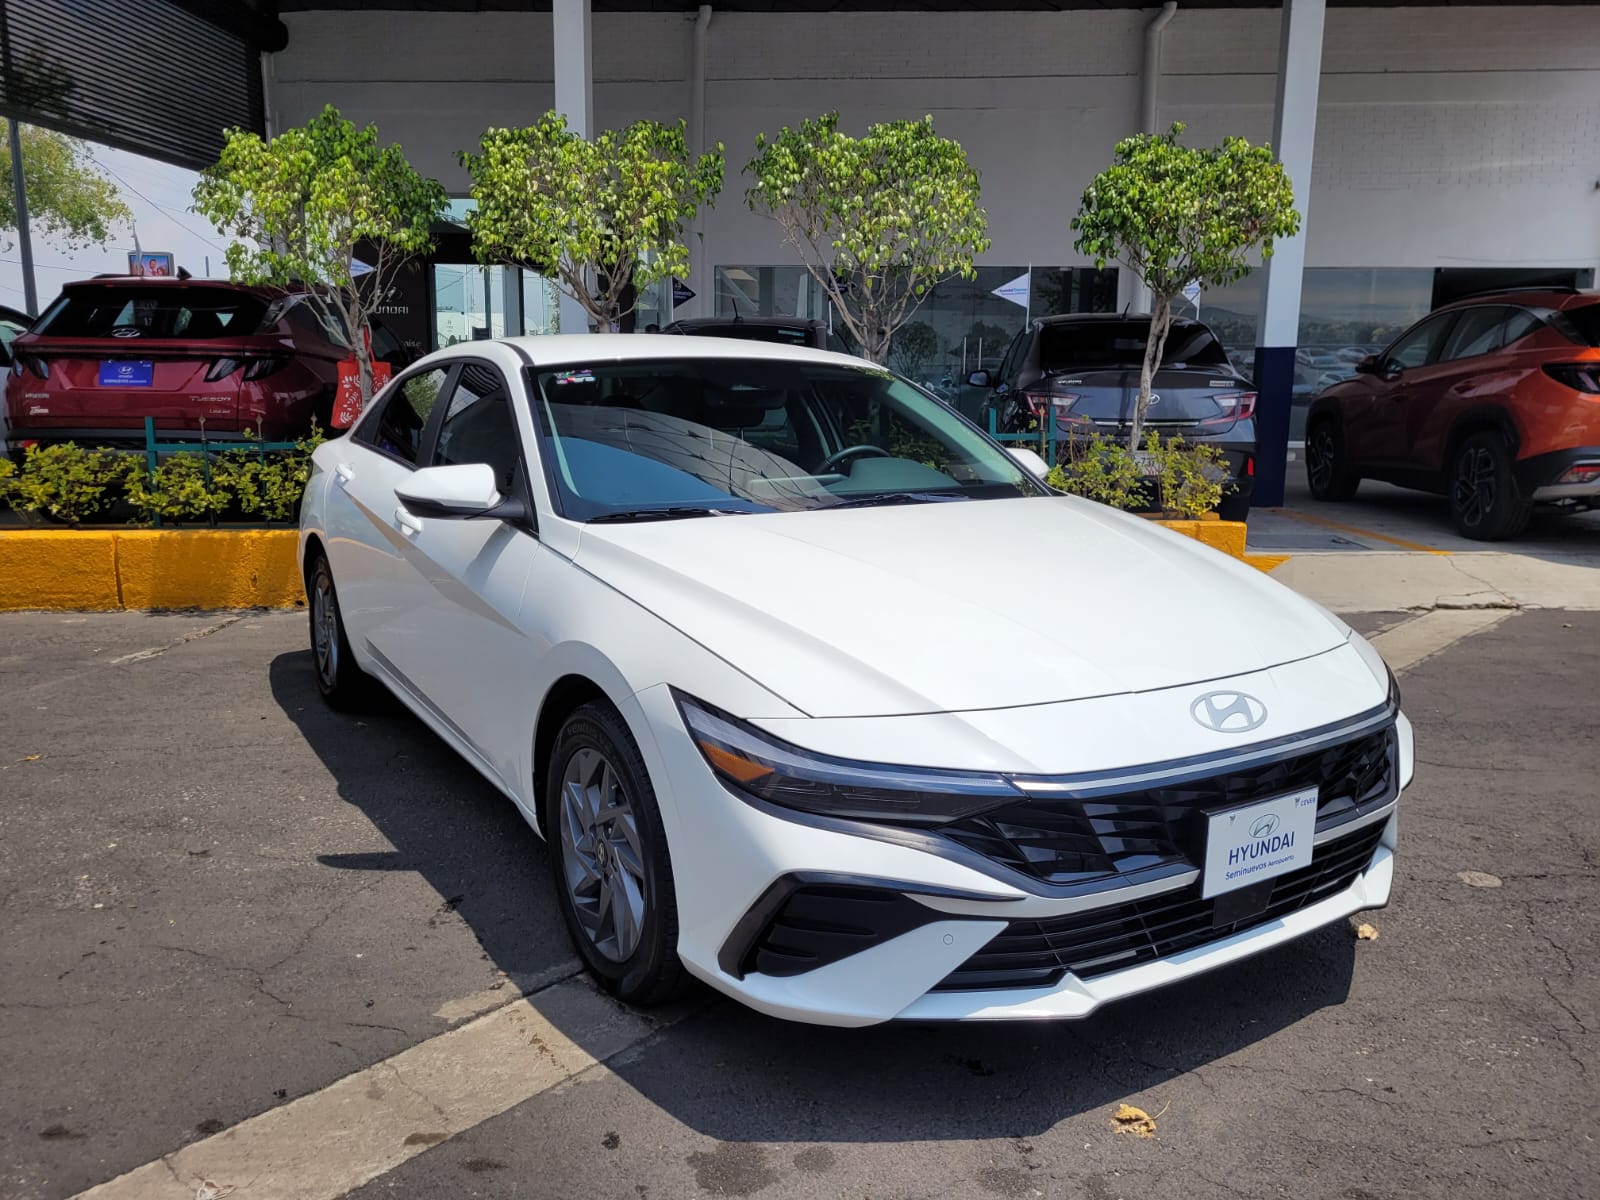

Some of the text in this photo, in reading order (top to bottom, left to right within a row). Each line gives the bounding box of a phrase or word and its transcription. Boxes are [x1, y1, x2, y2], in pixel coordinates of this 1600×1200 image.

[373, 305, 409, 315] UNDAI
[1228, 831, 1296, 866] HYUNDAI
[1225, 862, 1267, 881] Seminuevos
